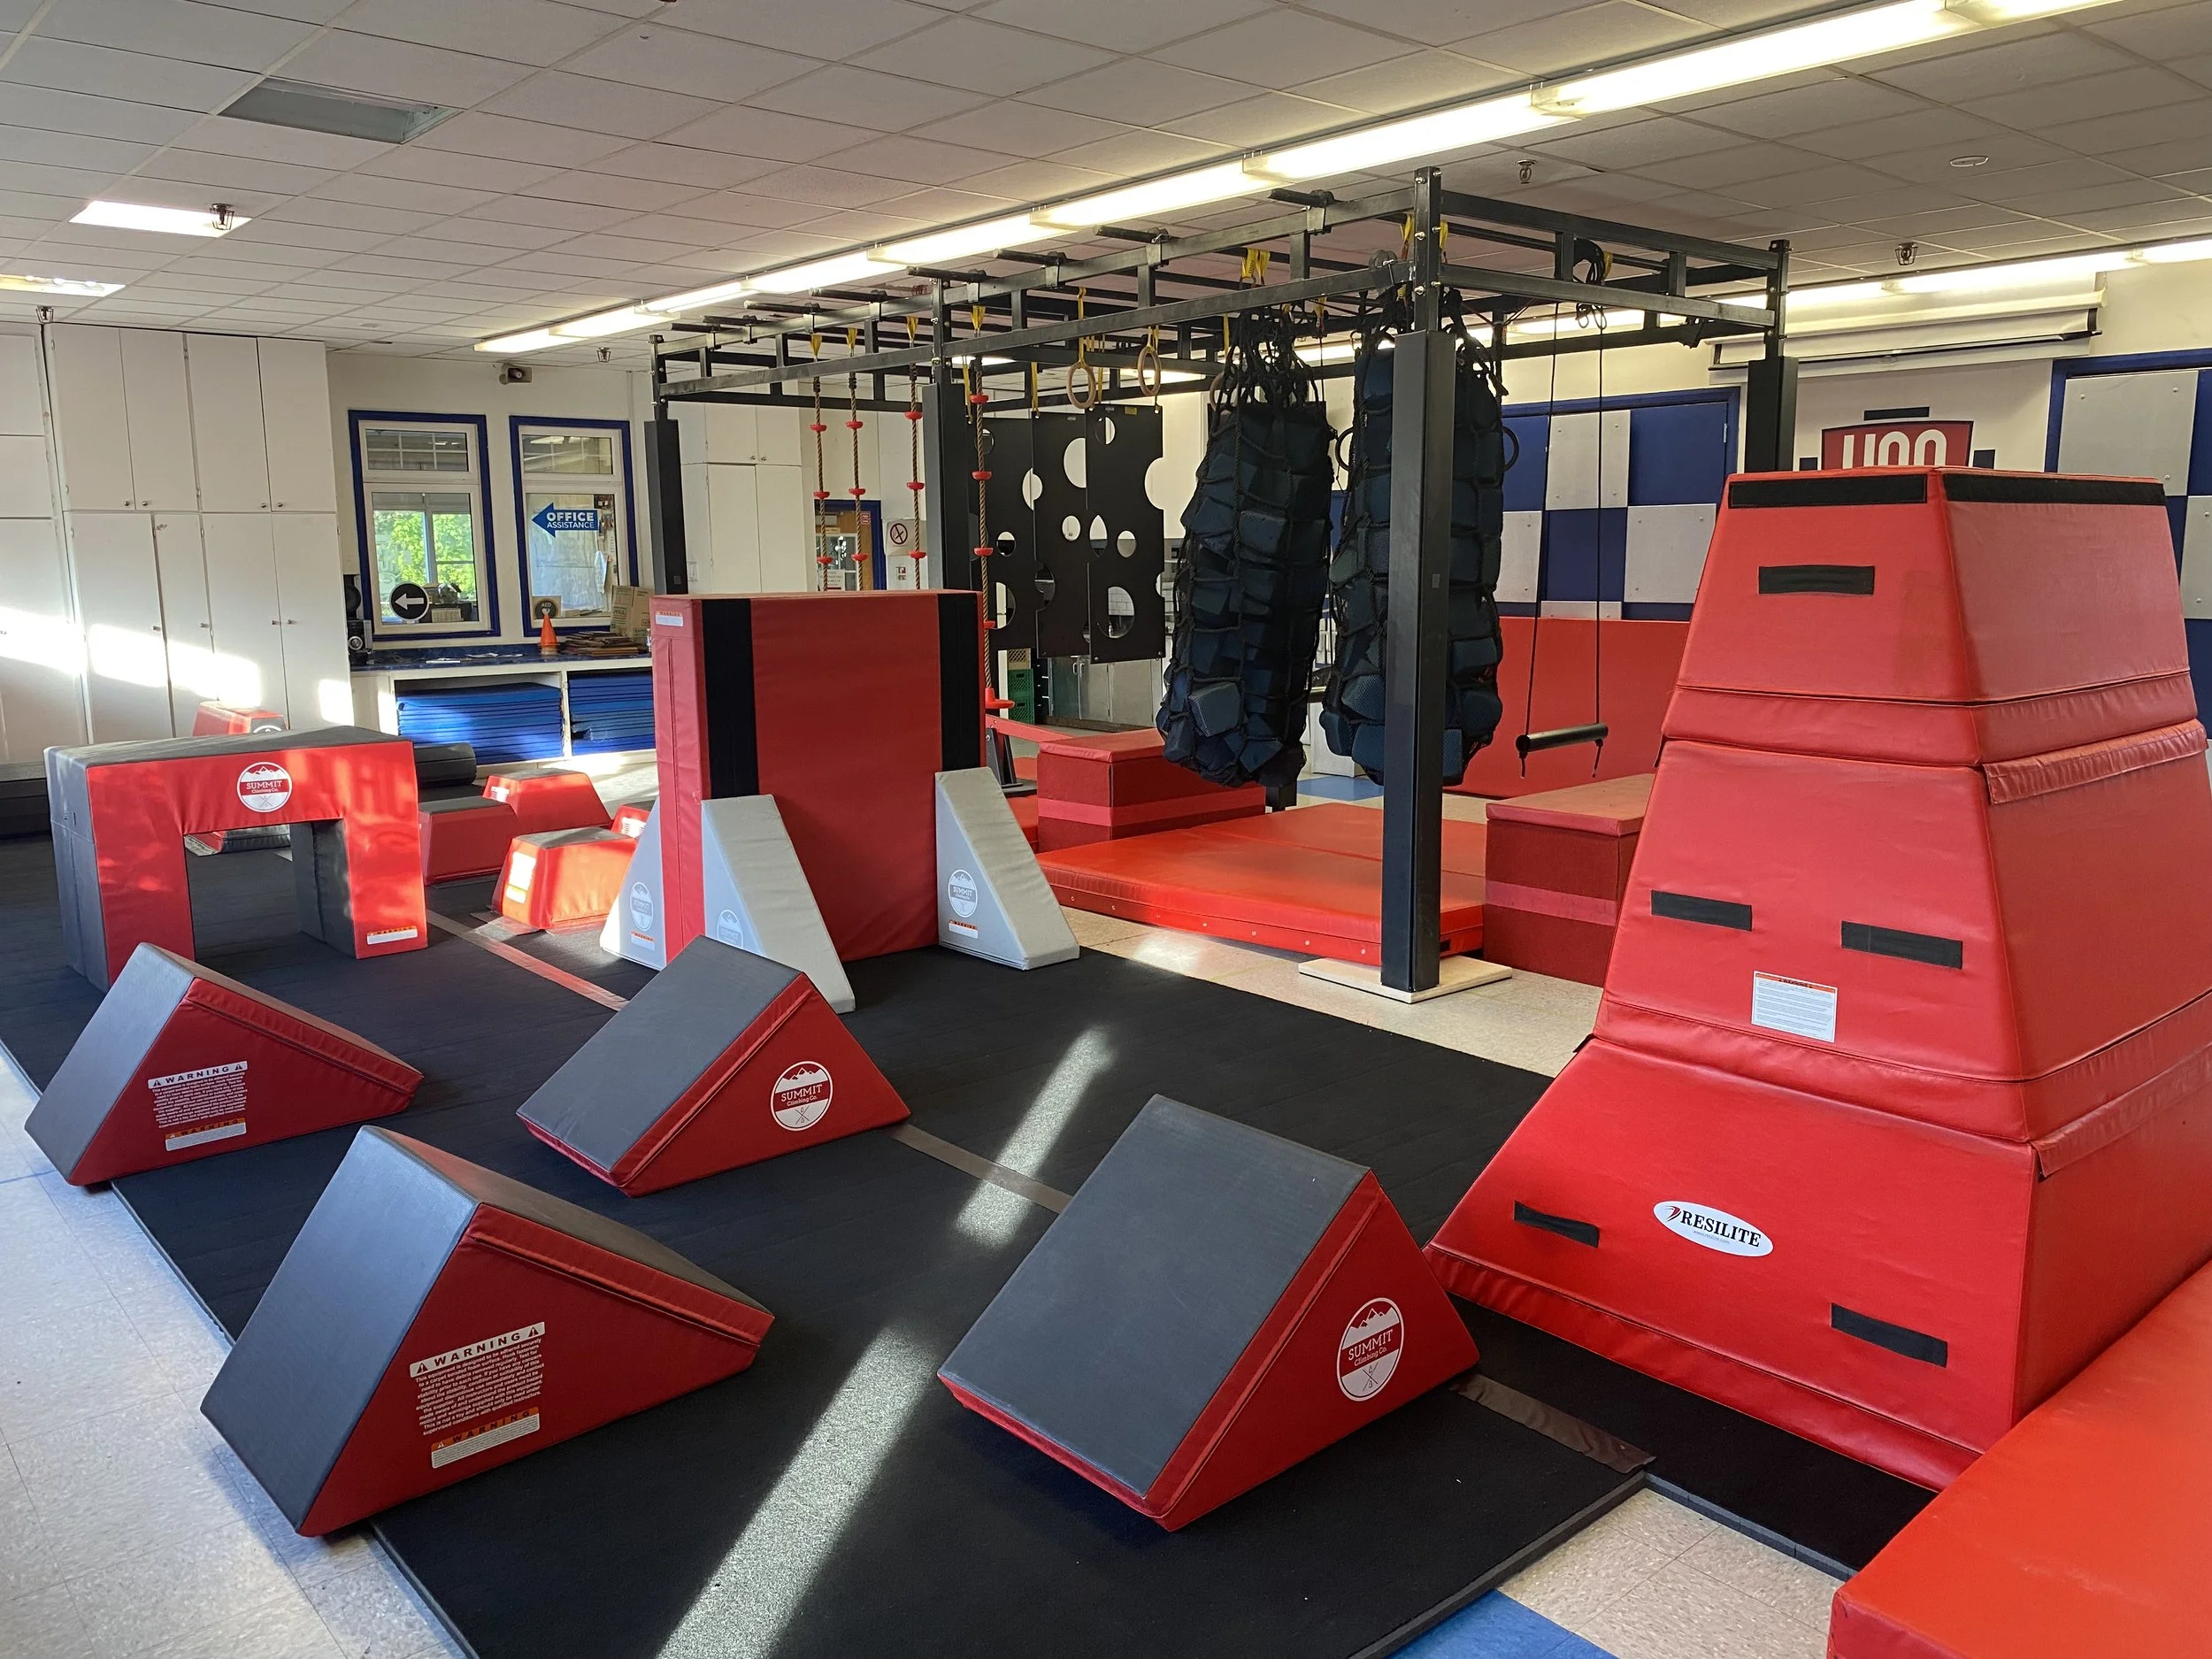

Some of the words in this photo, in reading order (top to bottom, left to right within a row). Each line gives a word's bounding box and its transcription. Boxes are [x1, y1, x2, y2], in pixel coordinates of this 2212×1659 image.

[546, 511, 595, 522] OFFICE
[246, 780, 282, 789] SUMMIT
[953, 886, 972, 896] SUMMIT
[165, 1066, 230, 1084] WARNING
[781, 1084, 823, 1102] SUMMIT
[787, 1097, 810, 1107] Climbing
[1680, 1210, 1762, 1248] RESILITE
[434, 1333, 520, 1367] WARNING
[1348, 1328, 1394, 1361] SUMMIT
[1354, 1349, 1379, 1366] Climbing
[452, 1409, 531, 1443] WARNING
